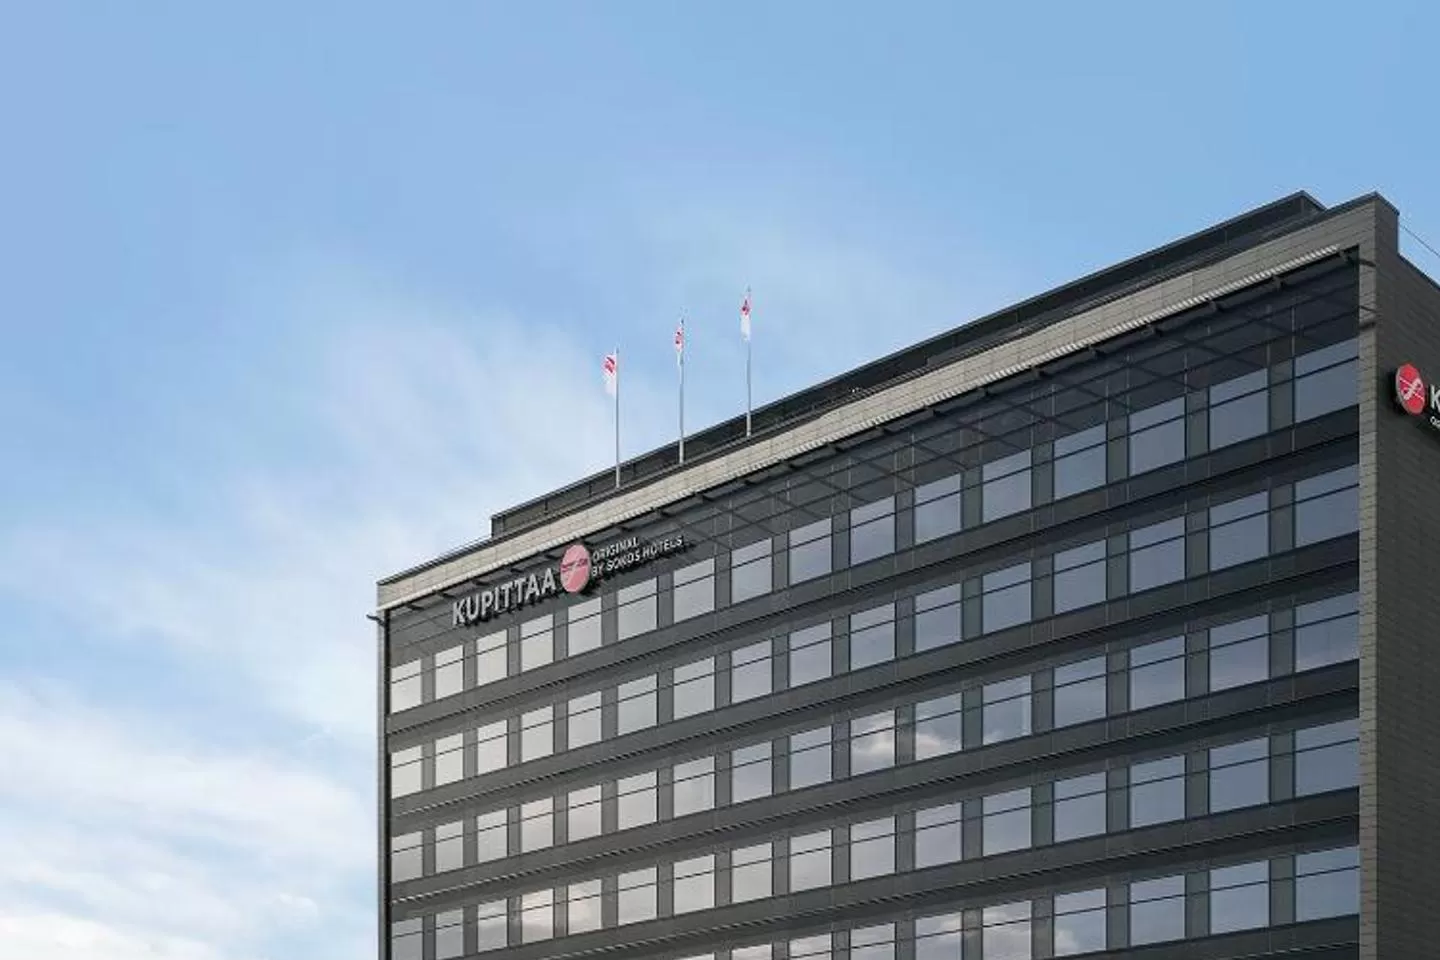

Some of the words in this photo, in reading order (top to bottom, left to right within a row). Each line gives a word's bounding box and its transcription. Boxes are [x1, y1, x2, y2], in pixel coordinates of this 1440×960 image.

[591, 564, 604, 577] BY
[606, 551, 640, 572] SOKOS
[642, 535, 684, 558] HOTELS
[592, 536, 640, 562] ORIGINAL
[452, 567, 556, 625] KUPITTAA
